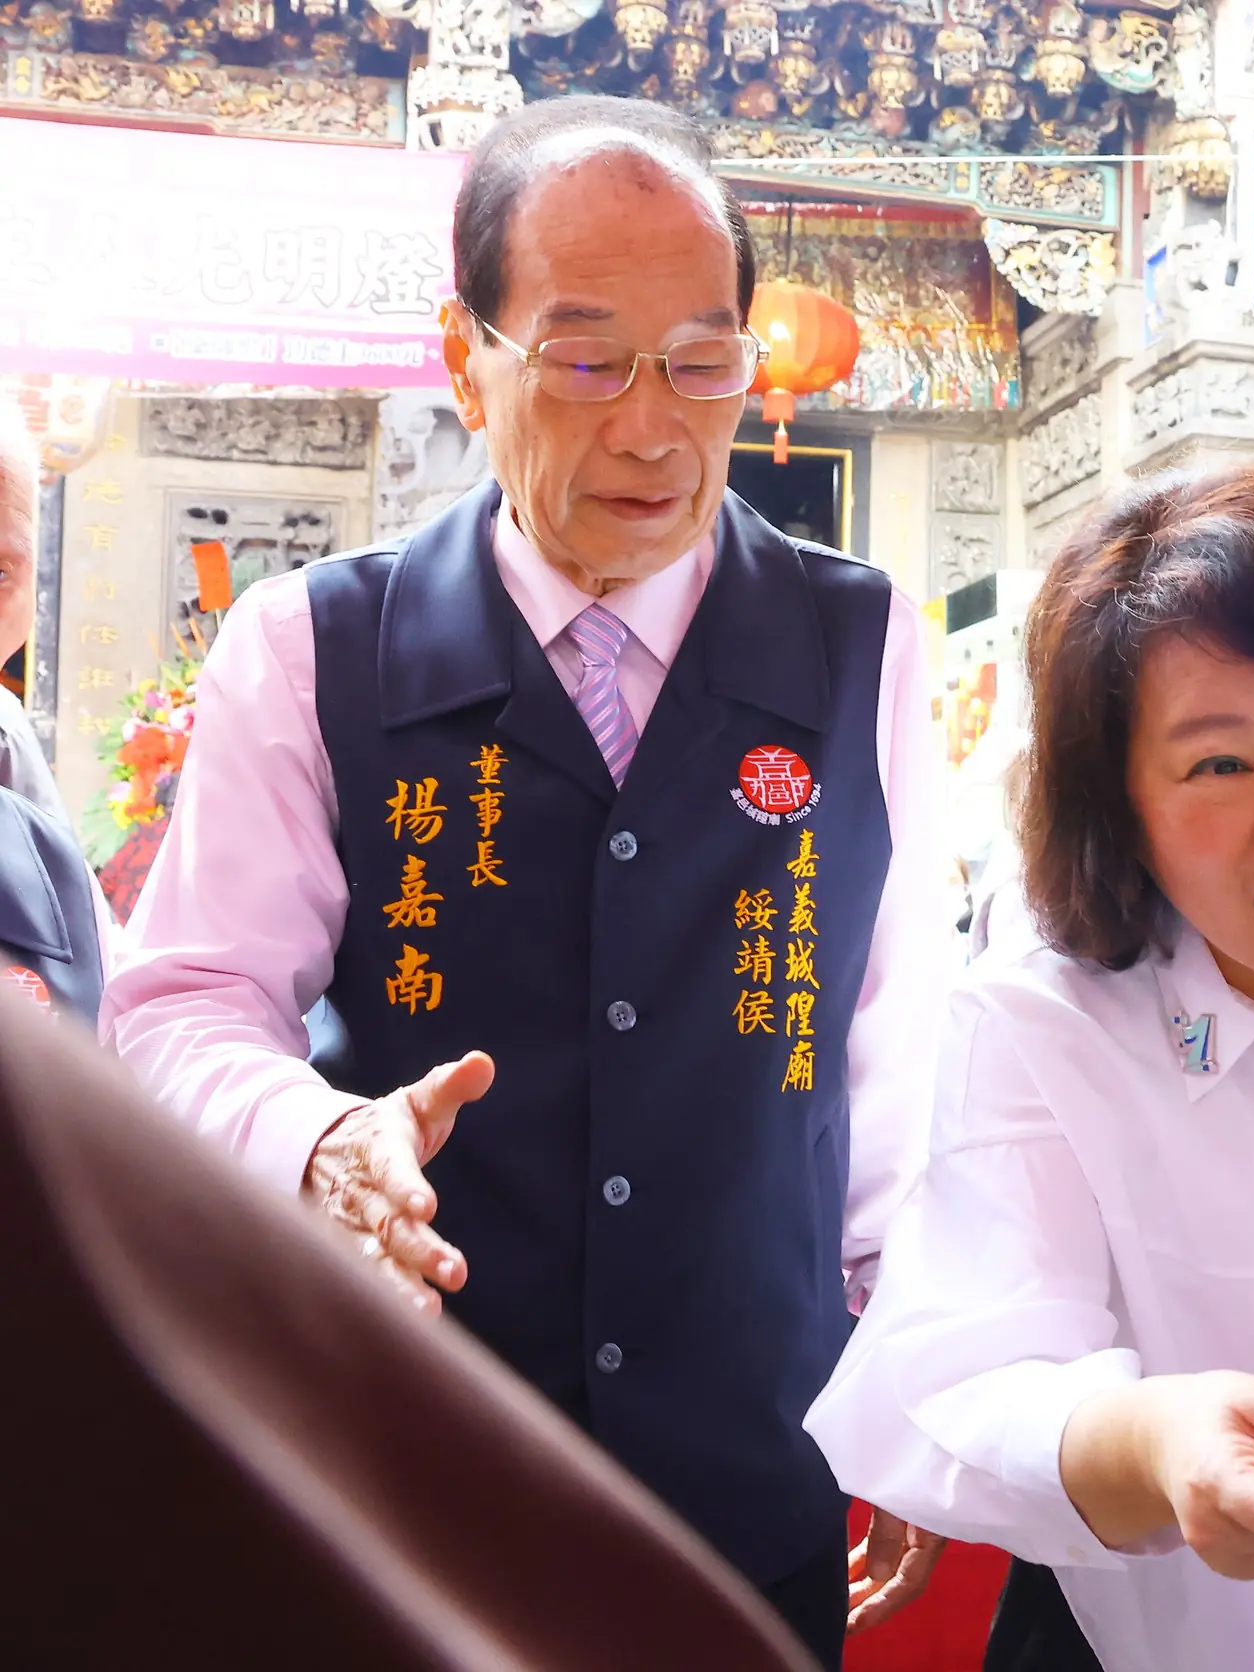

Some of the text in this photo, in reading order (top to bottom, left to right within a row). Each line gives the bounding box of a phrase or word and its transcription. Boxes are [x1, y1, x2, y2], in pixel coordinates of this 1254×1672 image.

[466, 744, 509, 888] 董事長
[785, 805, 811, 824] Since
[383, 777, 448, 1015] 楊嘉南
[732, 888, 779, 1035] 綏靖侯
[781, 828, 821, 1093] 嘉義城隍廟
